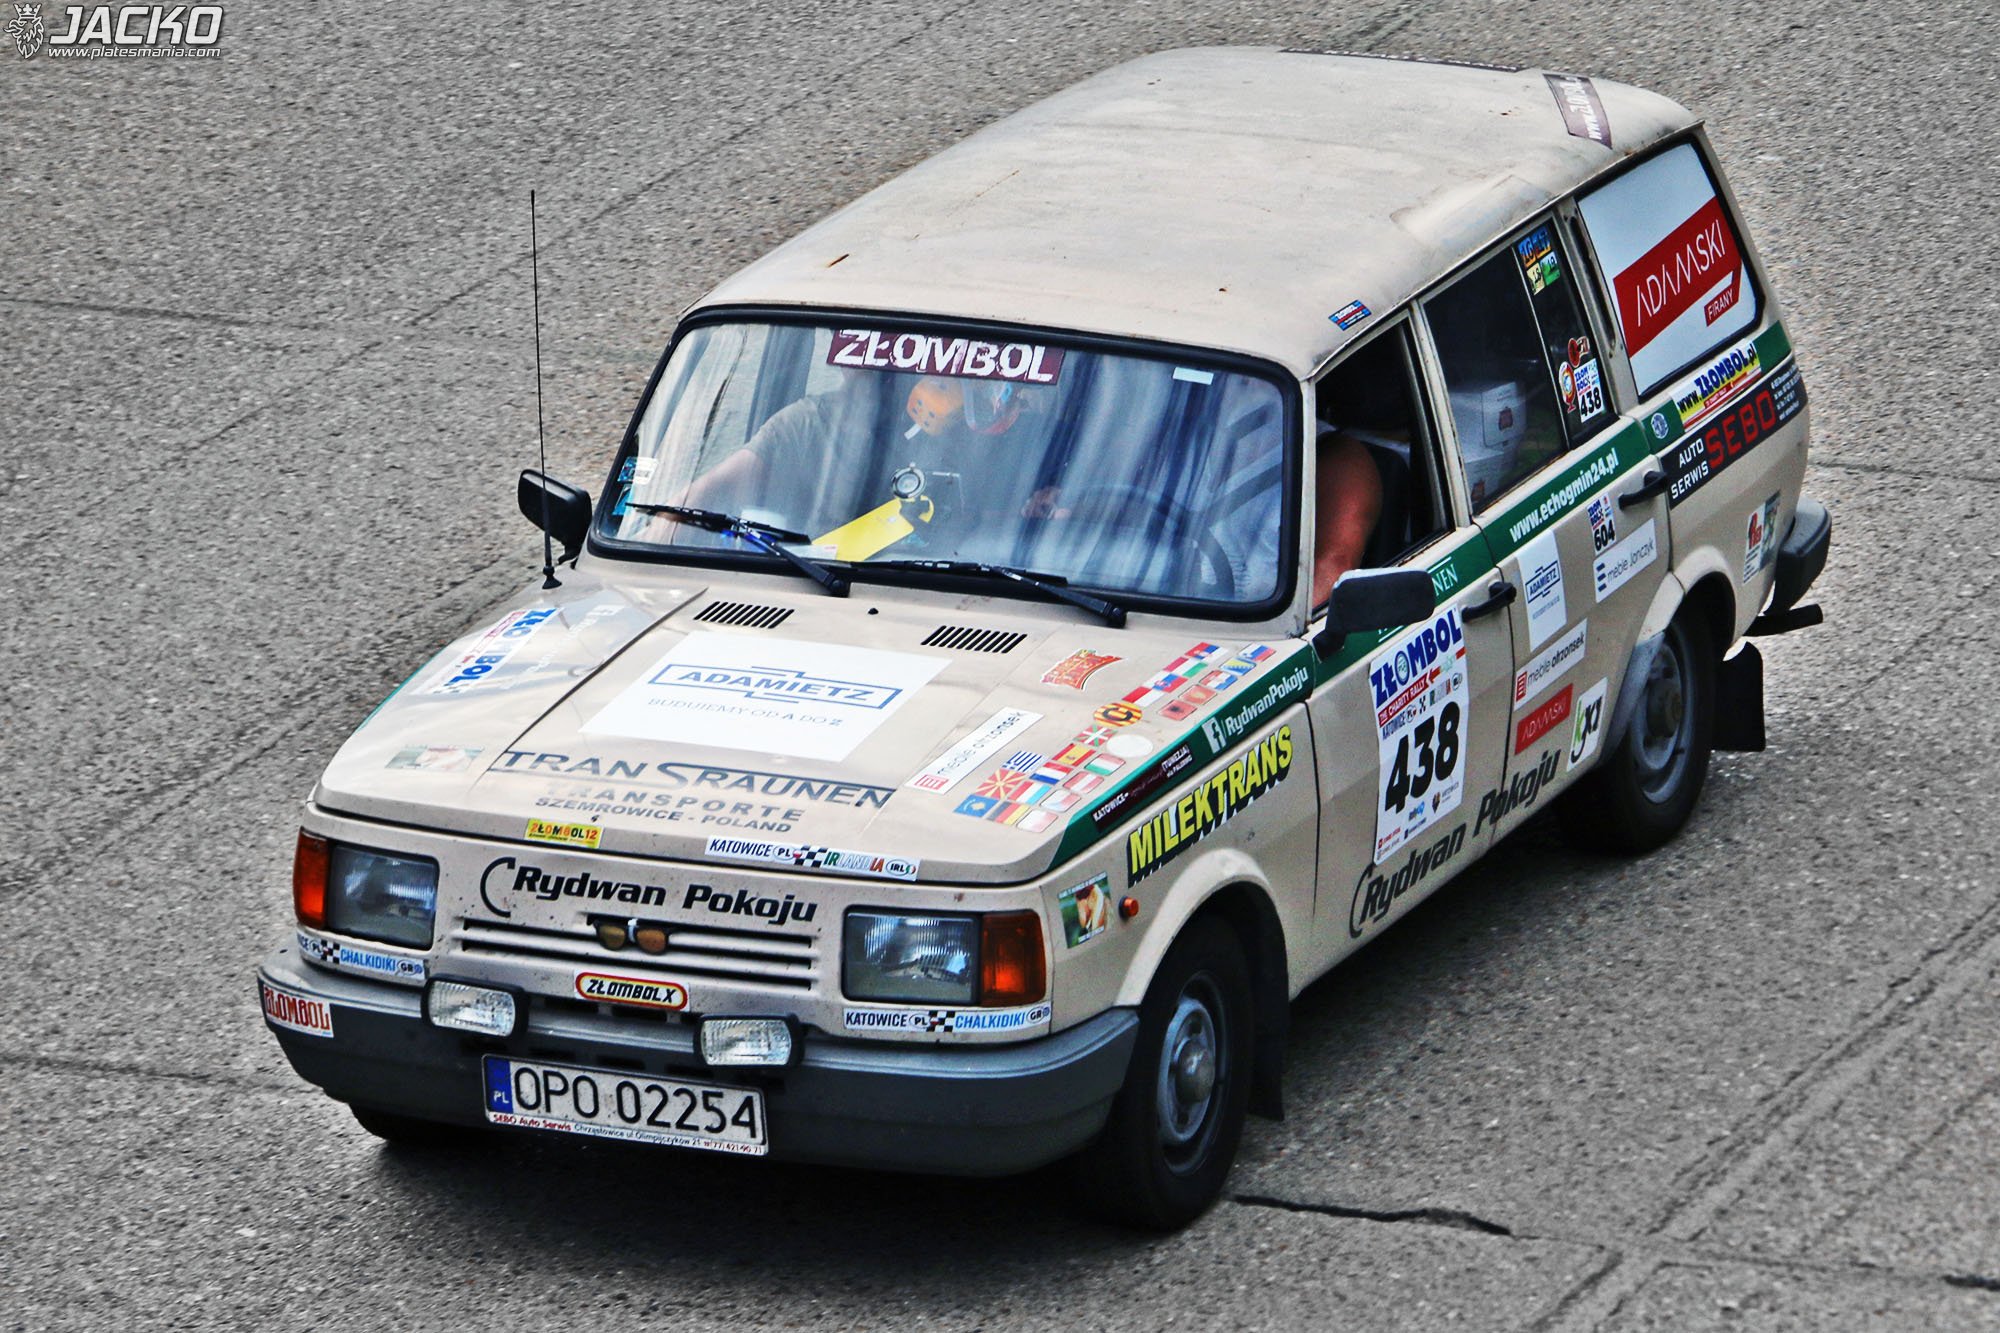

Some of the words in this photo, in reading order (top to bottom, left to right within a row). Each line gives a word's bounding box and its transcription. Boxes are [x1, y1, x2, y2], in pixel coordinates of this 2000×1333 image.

[1636, 219, 1726, 327] ADAMSKI
[1707, 288, 1733, 320] FIRANY
[833, 329, 1053, 382] ZŁOMBOL
[1580, 386, 1601, 417] 438
[1705, 390, 1777, 469] SEBO
[1679, 438, 1704, 468] AUTO
[1509, 447, 1620, 544] www.echogmin24.pl
[1671, 460, 1709, 500] SERWIS
[1594, 519, 1616, 551] 604
[1529, 569, 1558, 596] ADAMIETZ
[1370, 607, 1463, 709] ZŁOMBOL
[677, 671, 875, 701] ADAMIETZ
[1224, 666, 1310, 736] RydwanPokoju
[1384, 701, 1461, 815] 438
[534, 797, 680, 822] SZEMROWICE
[701, 814, 793, 834] POLAND
[1127, 724, 1293, 882] MILEKTRANS
[709, 838, 774, 858] KATOWICE
[777, 847, 791, 857] PL
[889, 862, 905, 873] IRL
[1359, 822, 1467, 926] Rydwan
[1473, 749, 1562, 838] Pokoju
[511, 865, 667, 906] Rydwan
[681, 884, 818, 926] Pokoju
[340, 948, 396, 972] CHALKIDIKI
[845, 1011, 908, 1027] KATOWICE
[913, 1016, 928, 1026] PL
[955, 1012, 1026, 1029] CHALKIDIKI
[493, 1090, 510, 1104] PL
[514, 1067, 600, 1119] OPO
[615, 1080, 757, 1139] 02254
